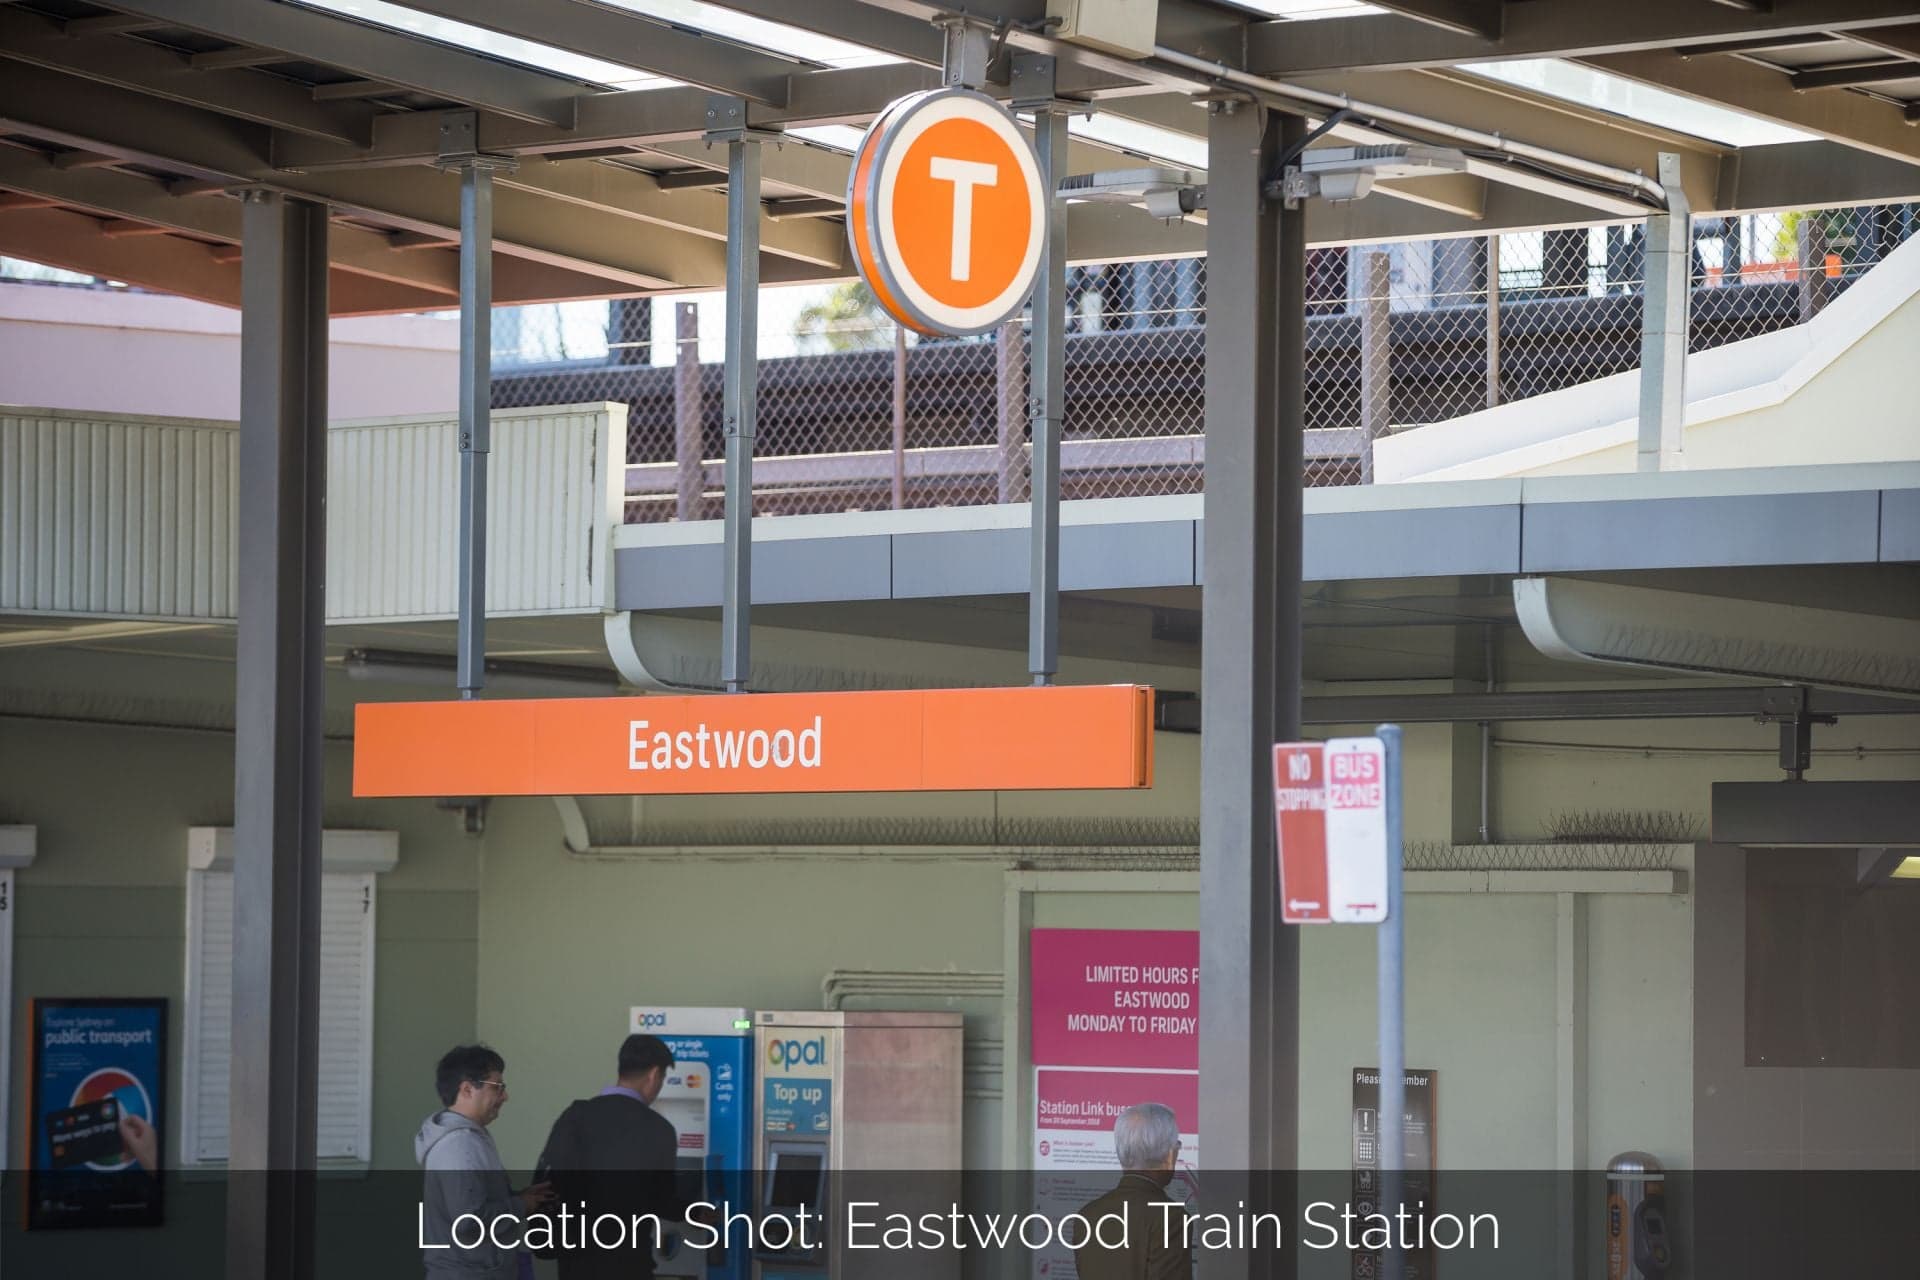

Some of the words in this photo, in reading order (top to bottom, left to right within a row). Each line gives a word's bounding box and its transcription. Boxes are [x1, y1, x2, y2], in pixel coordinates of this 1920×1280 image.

[928, 155, 998, 282] T
[628, 715, 822, 770] Eastwood
[1288, 754, 1311, 781] NO
[1334, 755, 1375, 779] BUS
[1331, 783, 1380, 807] ZONE
[1085, 965, 1139, 984] LIMITED
[1142, 967, 1188, 985] HOURS
[1114, 991, 1190, 1009] EASTWOOD
[638, 1012, 666, 1030] opal
[1067, 1014, 1126, 1032] MONDAY
[1128, 1015, 1148, 1033] TO
[1151, 1016, 1197, 1034] FRIDAY
[45, 1029, 86, 1049] public
[88, 1030, 152, 1048] transport
[768, 1035, 825, 1072] opal
[1356, 1072, 1382, 1085] Pleas
[774, 1083, 798, 1104] Top
[802, 1087, 822, 1105] up
[1040, 1100, 1080, 1116] Station
[1081, 1101, 1103, 1116] Link
